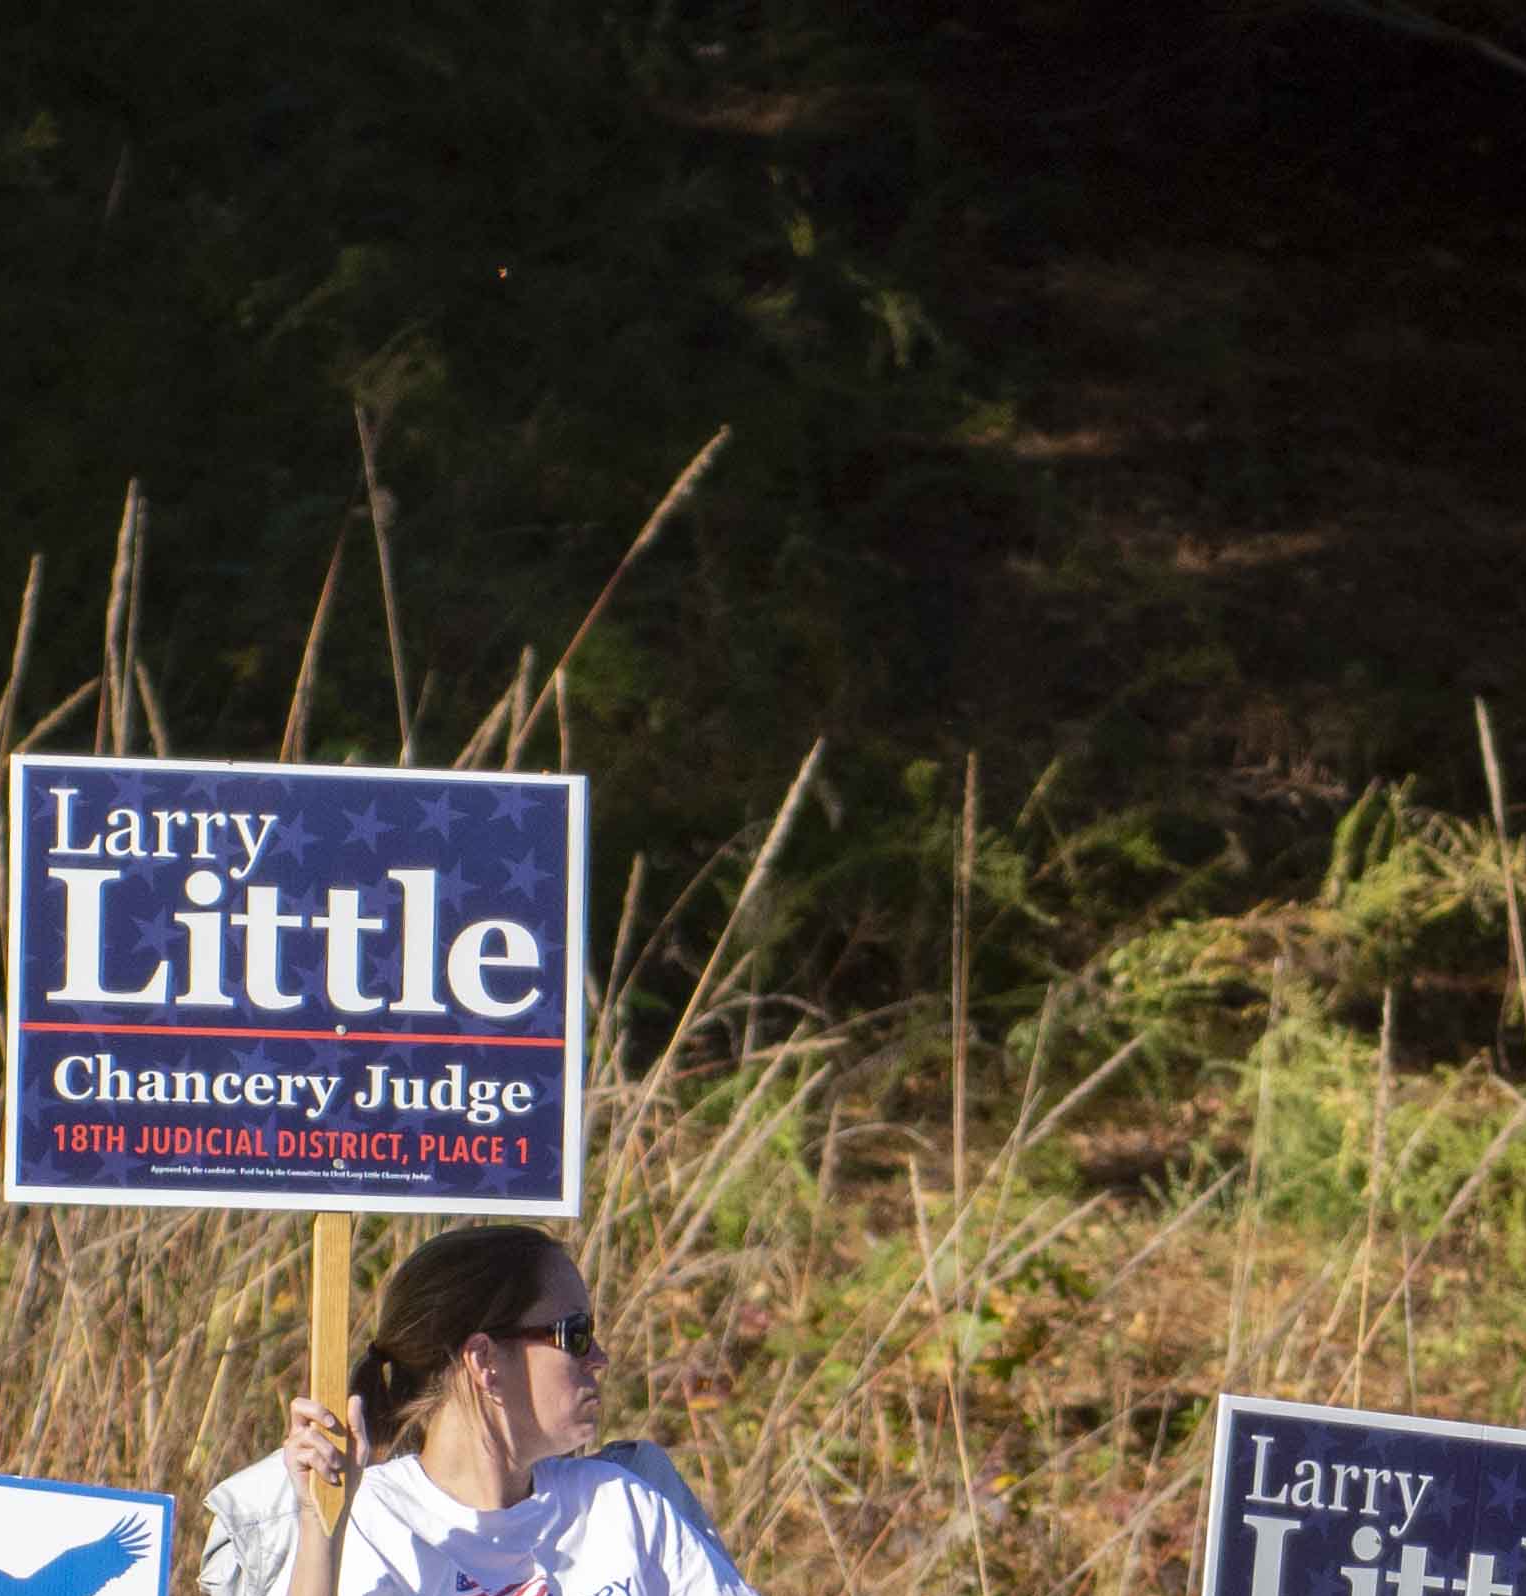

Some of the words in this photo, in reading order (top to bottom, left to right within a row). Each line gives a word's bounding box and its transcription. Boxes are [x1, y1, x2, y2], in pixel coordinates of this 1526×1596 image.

[48, 787, 278, 879] Larry
[46, 867, 541, 1018] Little
[53, 1053, 341, 1118] Chancery
[355, 1063, 533, 1124] Judge
[53, 1124, 125, 1153] 18TH
[134, 1126, 269, 1157] JUDICIAL
[279, 1130, 409, 1165] DISTRICT,
[420, 1135, 504, 1164] PLACE
[516, 1137, 529, 1163] 1
[1245, 1434, 1433, 1537] Larry
